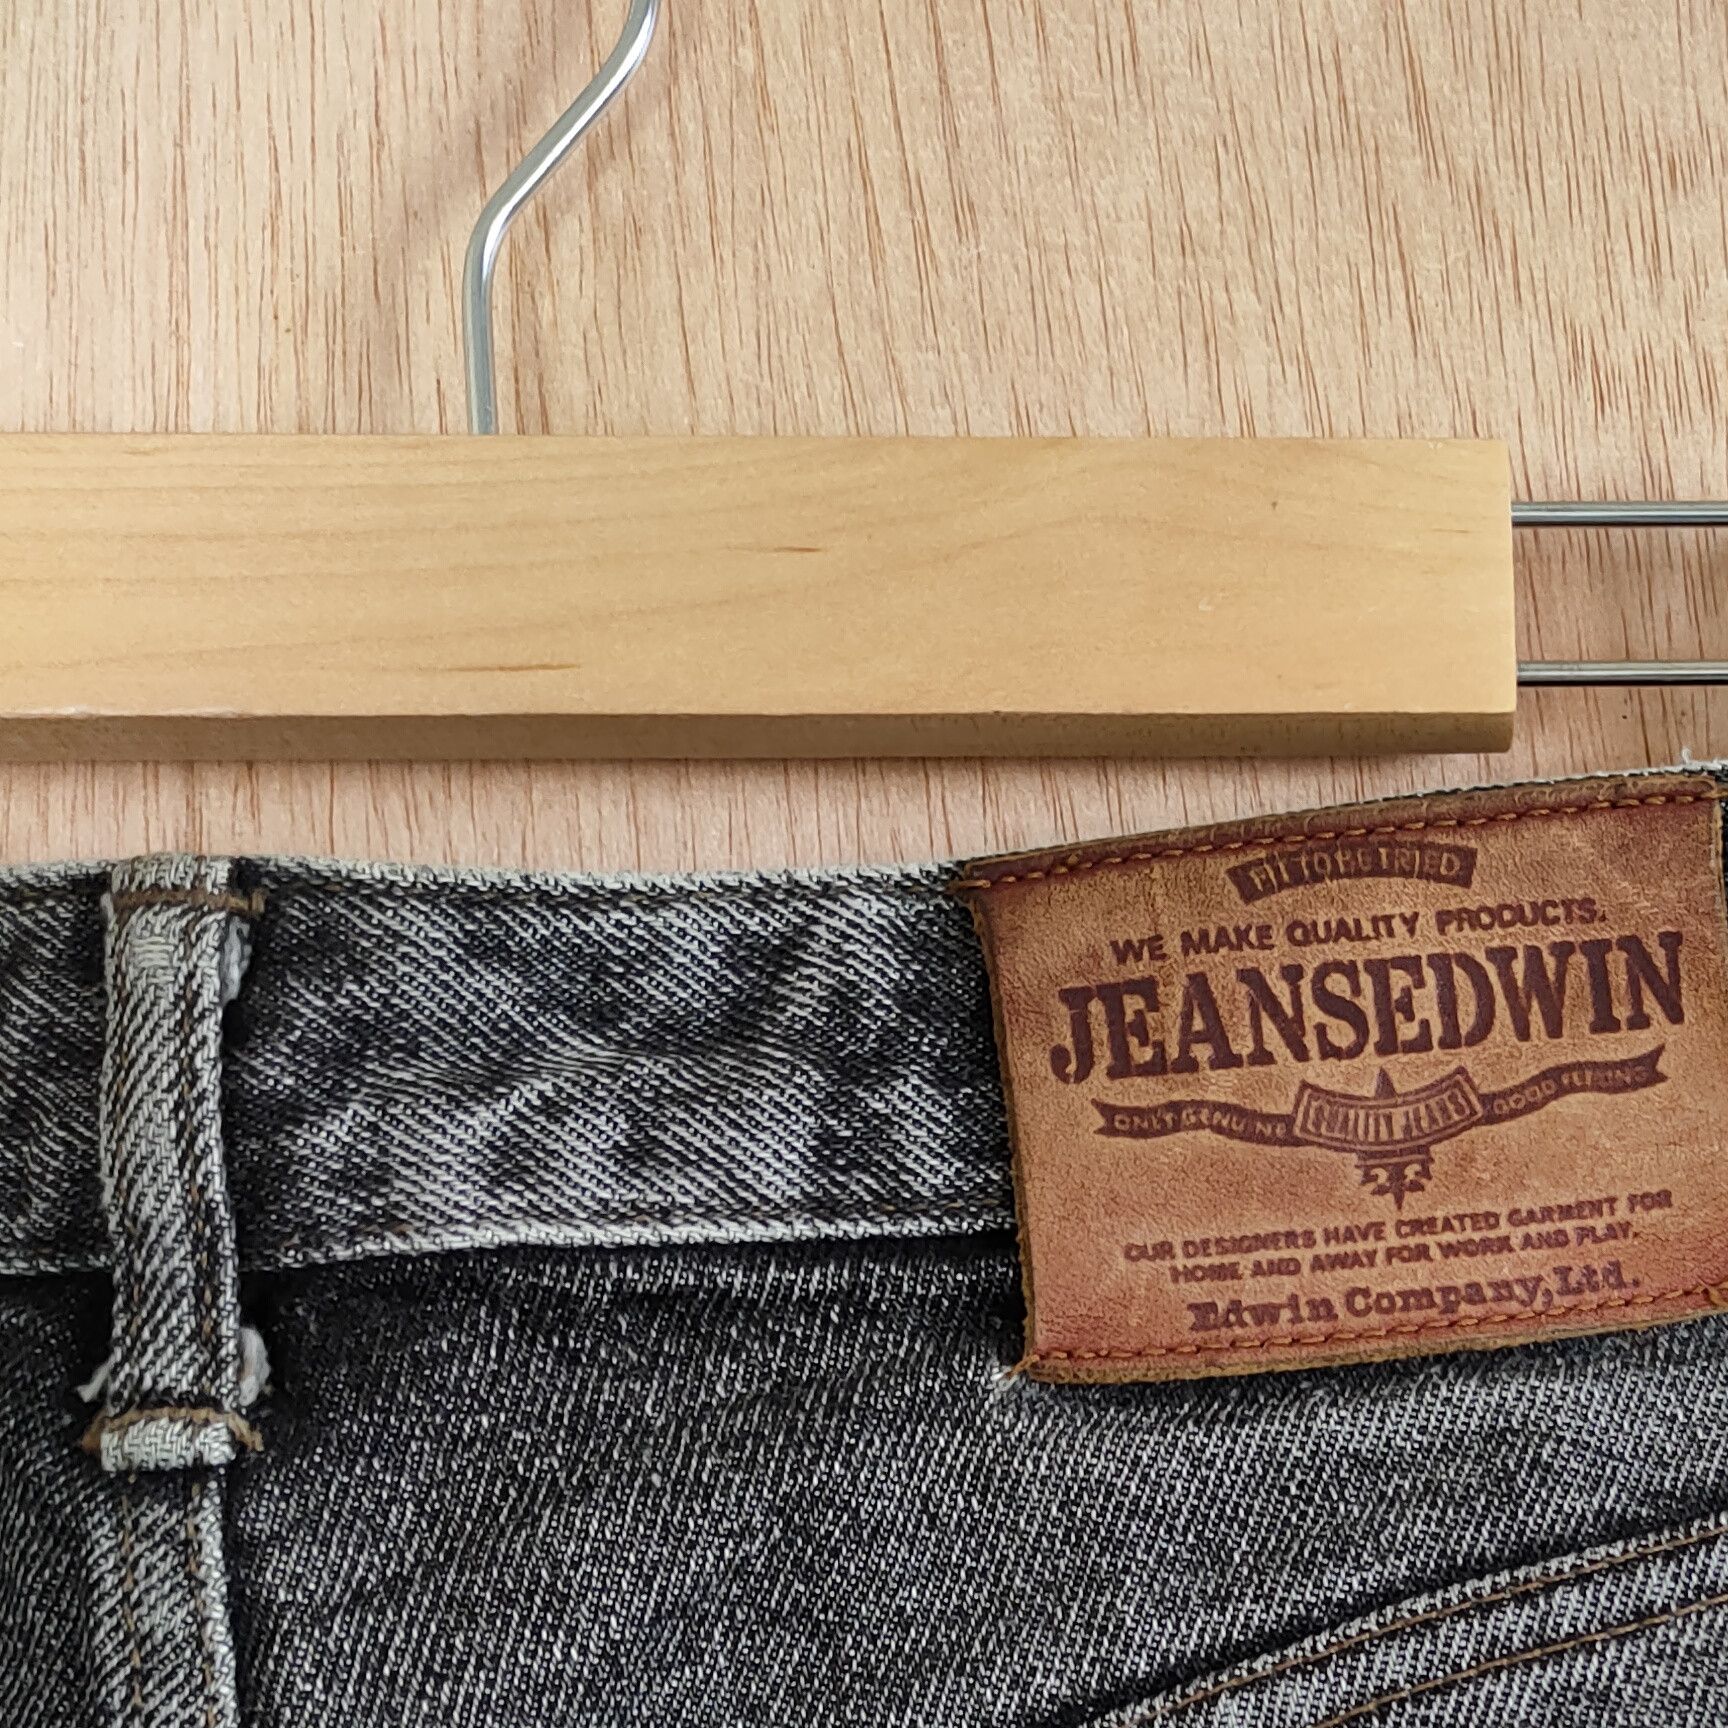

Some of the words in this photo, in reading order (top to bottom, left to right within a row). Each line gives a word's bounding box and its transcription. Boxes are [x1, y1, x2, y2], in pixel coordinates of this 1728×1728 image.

[1110, 934, 1168, 966] WE
[1180, 923, 1275, 957] MAKE
[1286, 911, 1419, 947] QUALITY
[1435, 897, 1607, 936] PRODUCTS.
[1050, 930, 1685, 1085] JEANSEDWIN
[1180, 1107, 1288, 1139] GENUNE
[1123, 1240, 1176, 1263] OUR
[1182, 1229, 1317, 1259] DESIGNERS
[1323, 1221, 1386, 1246] HAVE
[1395, 1211, 1500, 1239] CREATED
[1507, 1196, 1619, 1228] GARMENT
[1627, 1189, 1673, 1214] FOR
[1169, 1261, 1244, 1285] HOME
[1250, 1257, 1301, 1278] AND
[1310, 1249, 1378, 1273] AWAY
[1385, 1243, 1434, 1266] FOR
[1437, 1235, 1516, 1259] WORK
[1521, 1229, 1570, 1251] AND
[1187, 1293, 1339, 1332] Edwin
